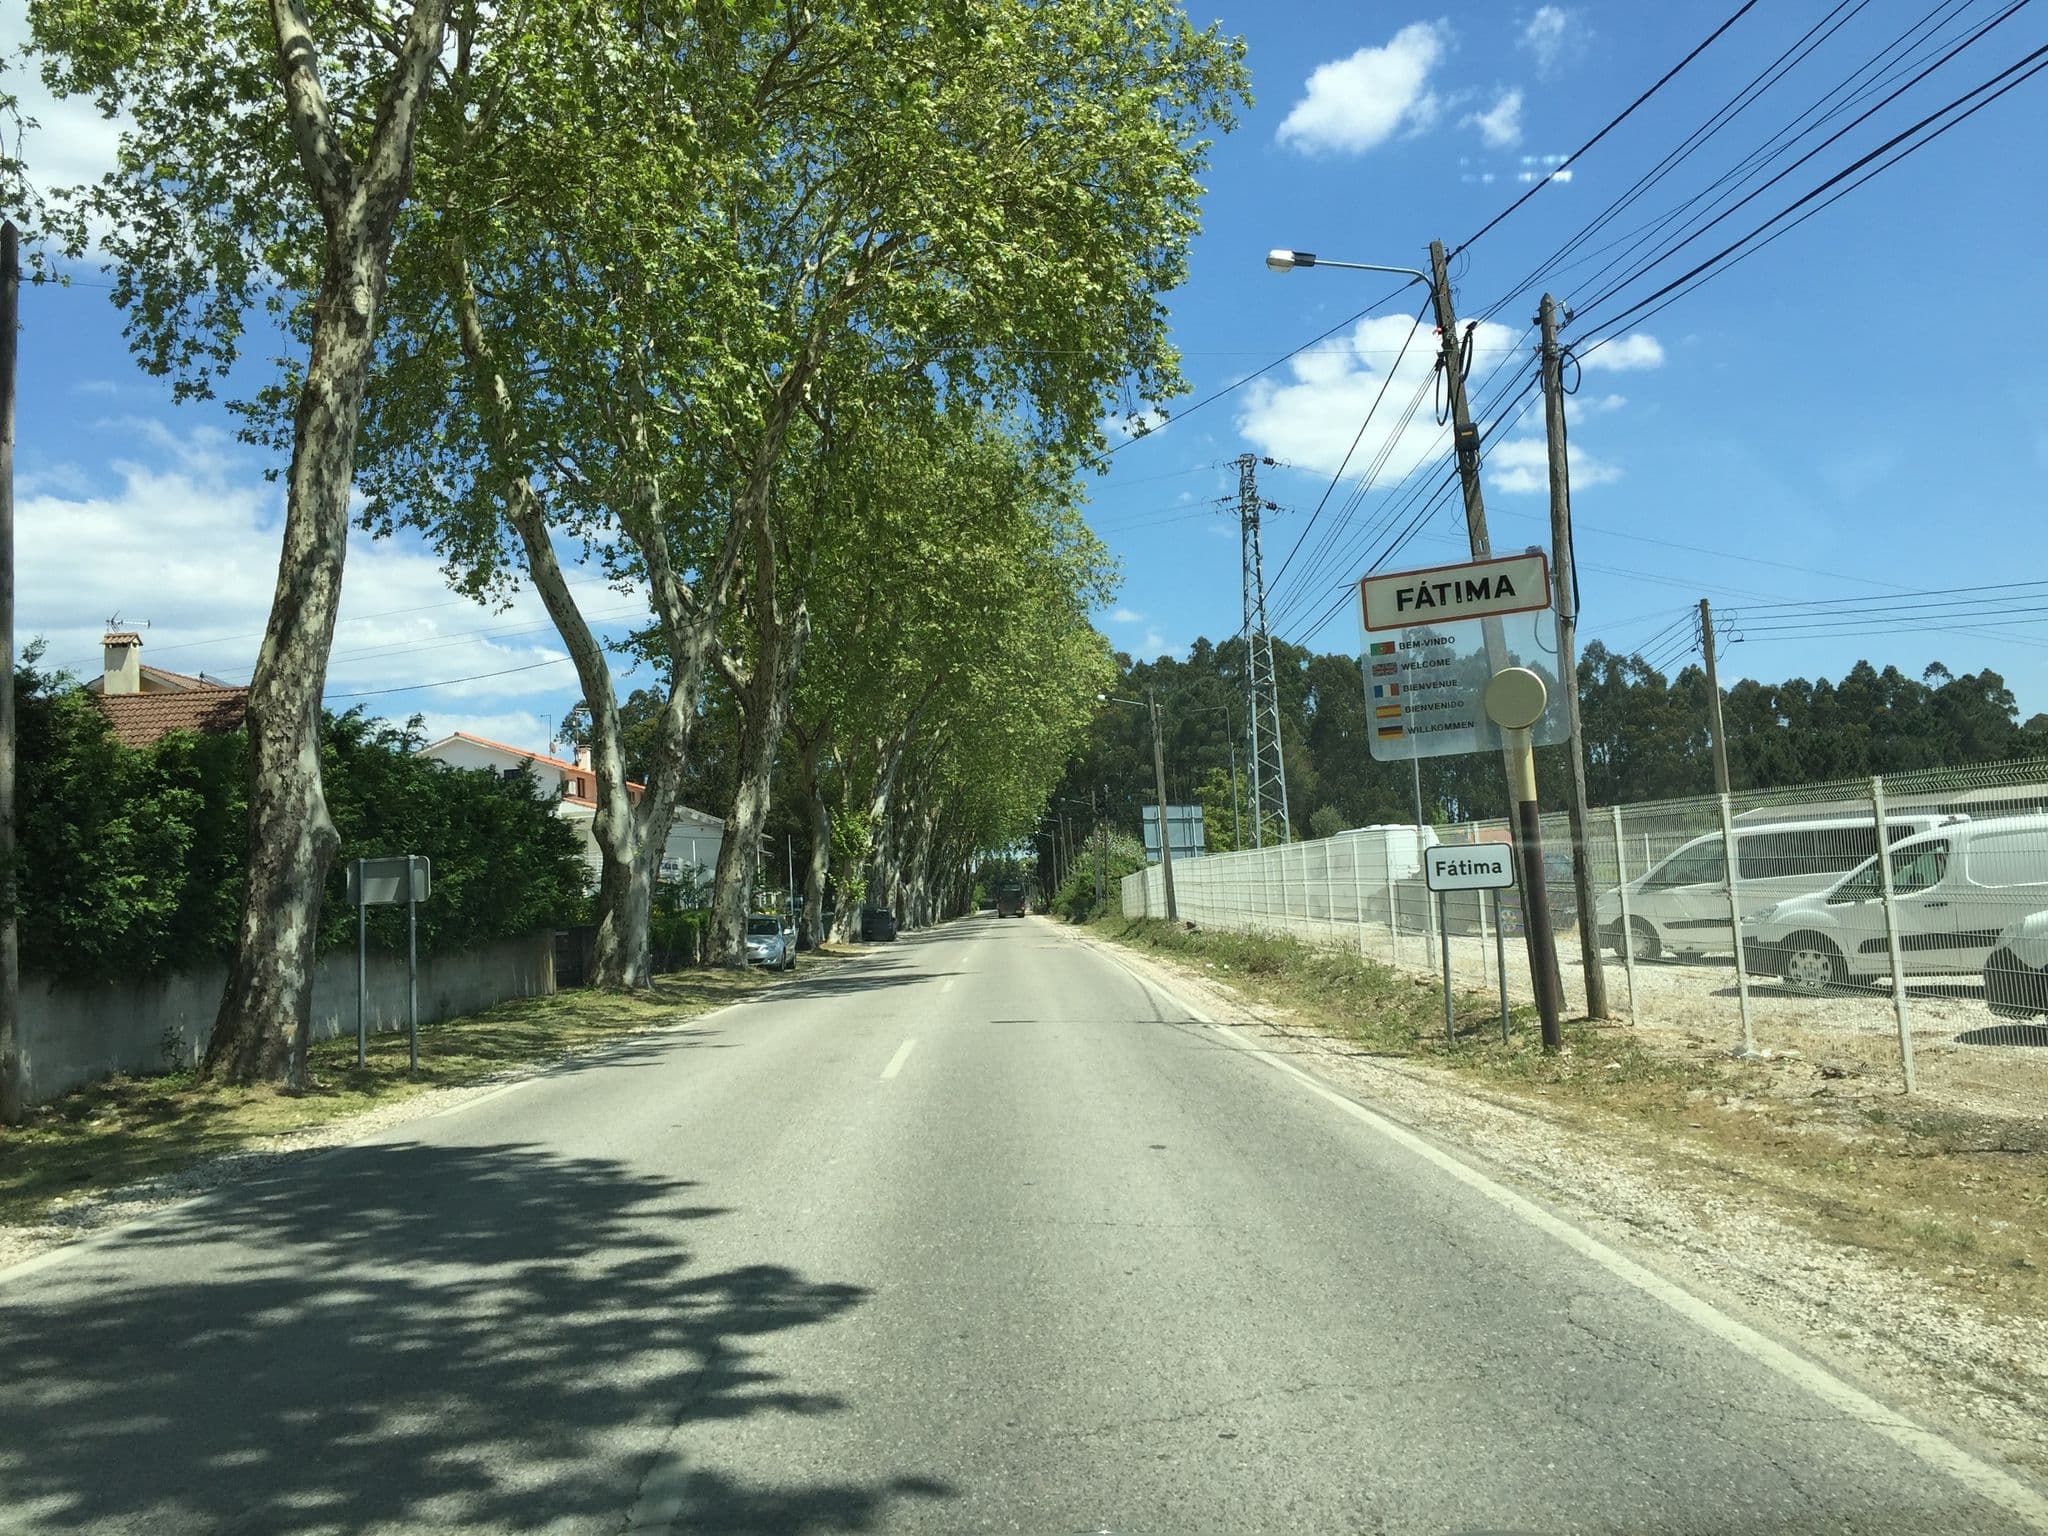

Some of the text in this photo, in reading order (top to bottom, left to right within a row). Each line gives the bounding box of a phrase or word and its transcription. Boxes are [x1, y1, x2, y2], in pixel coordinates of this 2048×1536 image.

[1396, 574, 1516, 612] FÁTIMA
[1399, 636, 1456, 651] BEM-VINDO
[1401, 658, 1451, 671] WELCOME
[1402, 679, 1458, 693] BIENVENUE
[1405, 700, 1465, 714] BIENVENIDO
[1407, 721, 1475, 735] WILLKOMMEN
[1436, 859, 1503, 877] Fátima
